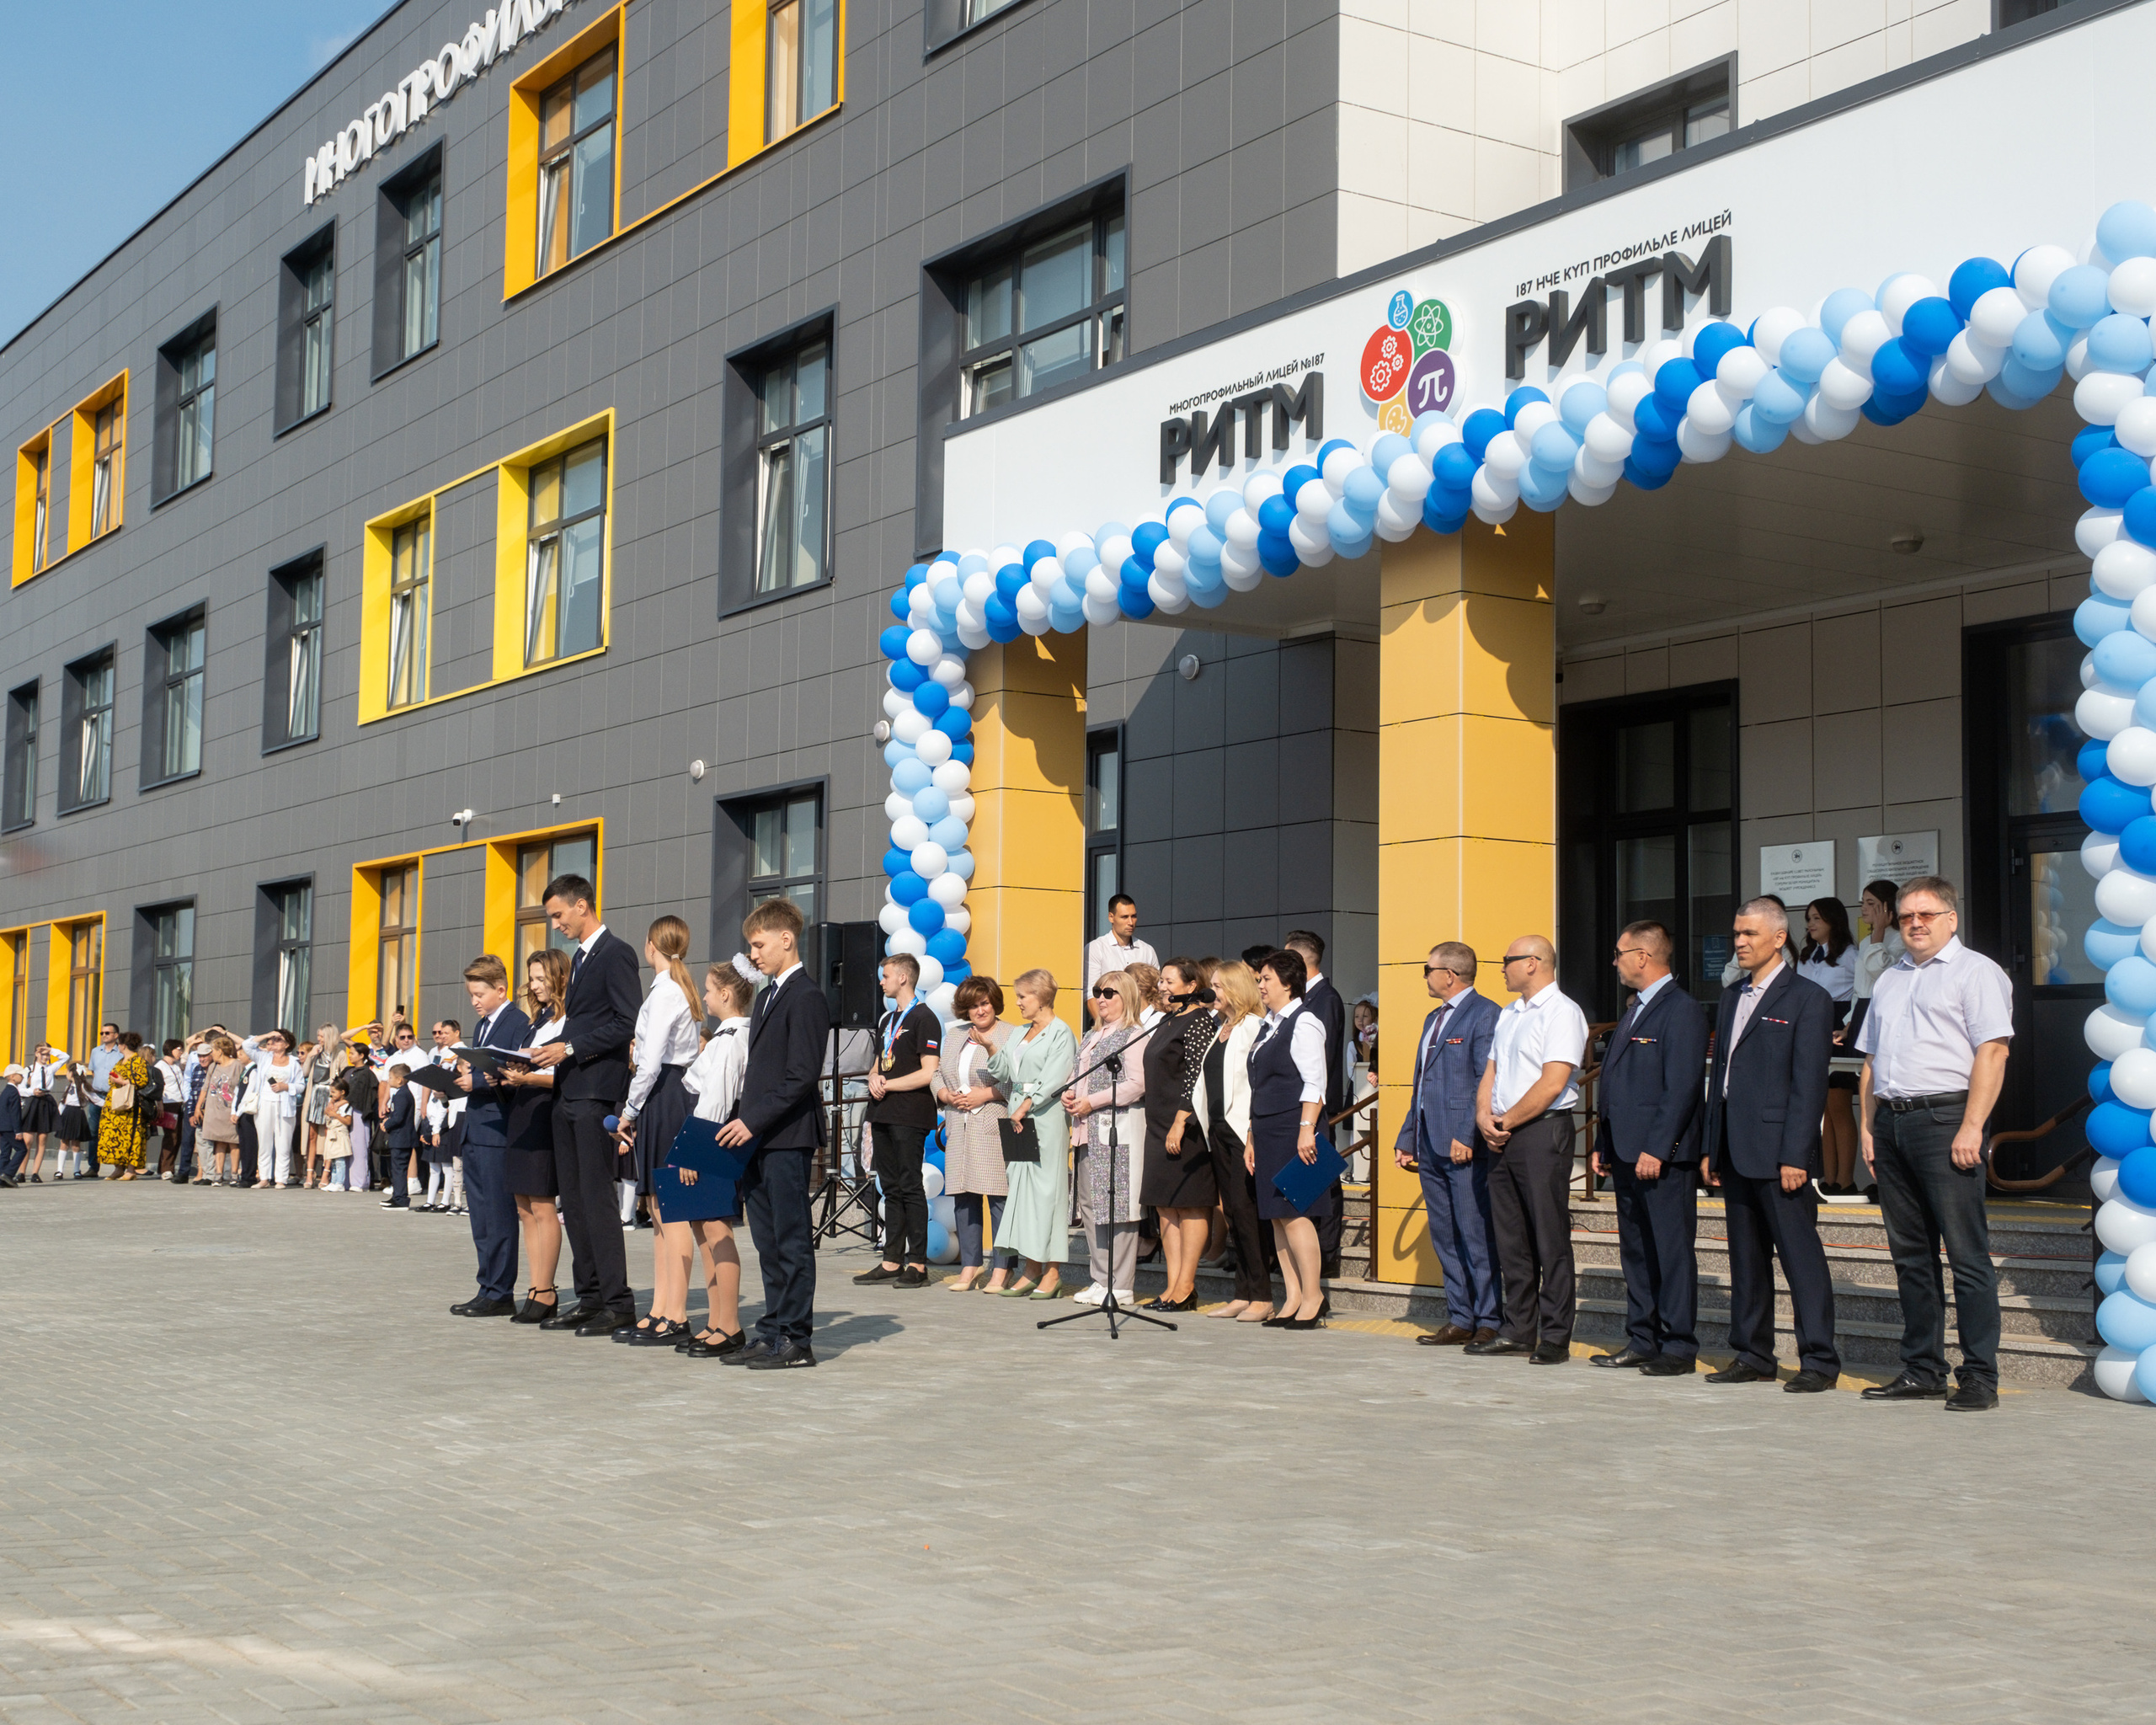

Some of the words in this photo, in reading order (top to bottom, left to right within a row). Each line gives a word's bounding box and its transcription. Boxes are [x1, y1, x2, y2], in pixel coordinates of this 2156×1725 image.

[1516, 280, 1533, 297] 187
[1536, 270, 1560, 290] НЧЕ
[1593, 231, 1678, 270] ПРОФИЛЬЛЕ
[1681, 209, 1732, 242] ЛИЦЕЙ
[1506, 234, 1732, 380] РИТМ
[1160, 371, 1324, 484] РИТМ
[1169, 371, 1263, 415] МНОГОПРОФИЛЬНЫЙ
[1265, 359, 1299, 384] ЛИЦЕЙ
[1300, 353, 1325, 371] №187
